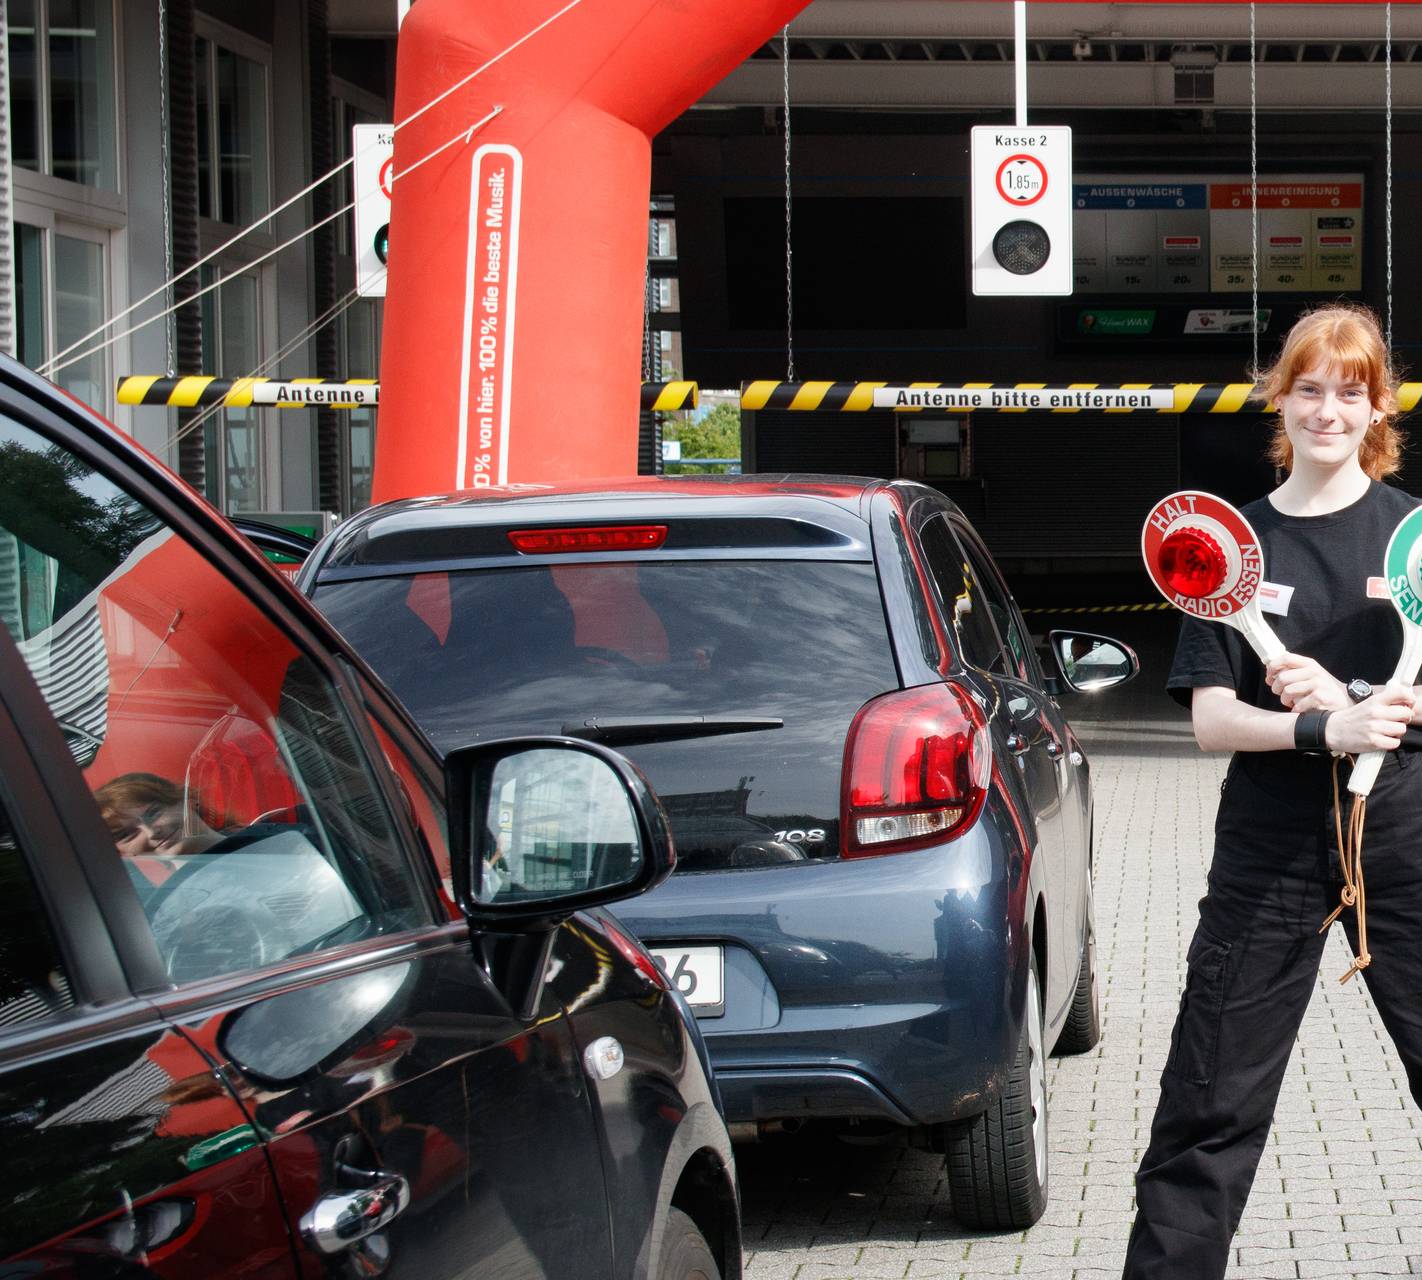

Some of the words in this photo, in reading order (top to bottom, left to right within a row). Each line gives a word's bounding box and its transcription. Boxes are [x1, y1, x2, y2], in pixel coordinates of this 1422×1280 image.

[995, 135, 1036, 146] Kasse
[1040, 135, 1047, 146] 2
[486, 168, 505, 228] Musik.
[1090, 186, 1183, 197] AUSSENWÄSCHE
[1242, 186, 1340, 196] INNENREINIGUNG
[484, 231, 502, 283] beste
[483, 286, 499, 313] die
[479, 316, 497, 371] 100%
[276, 386, 365, 403] Antenne
[476, 375, 494, 413] hier.
[896, 390, 982, 406] Antenne
[992, 391, 1041, 407] bitte
[1050, 391, 1152, 408] entfernen
[480, 417, 493, 449] von
[1150, 496, 1197, 533] HALT
[1174, 592, 1233, 617] RADIO
[1231, 544, 1260, 607] ESSEN
[774, 829, 825, 842] 108
